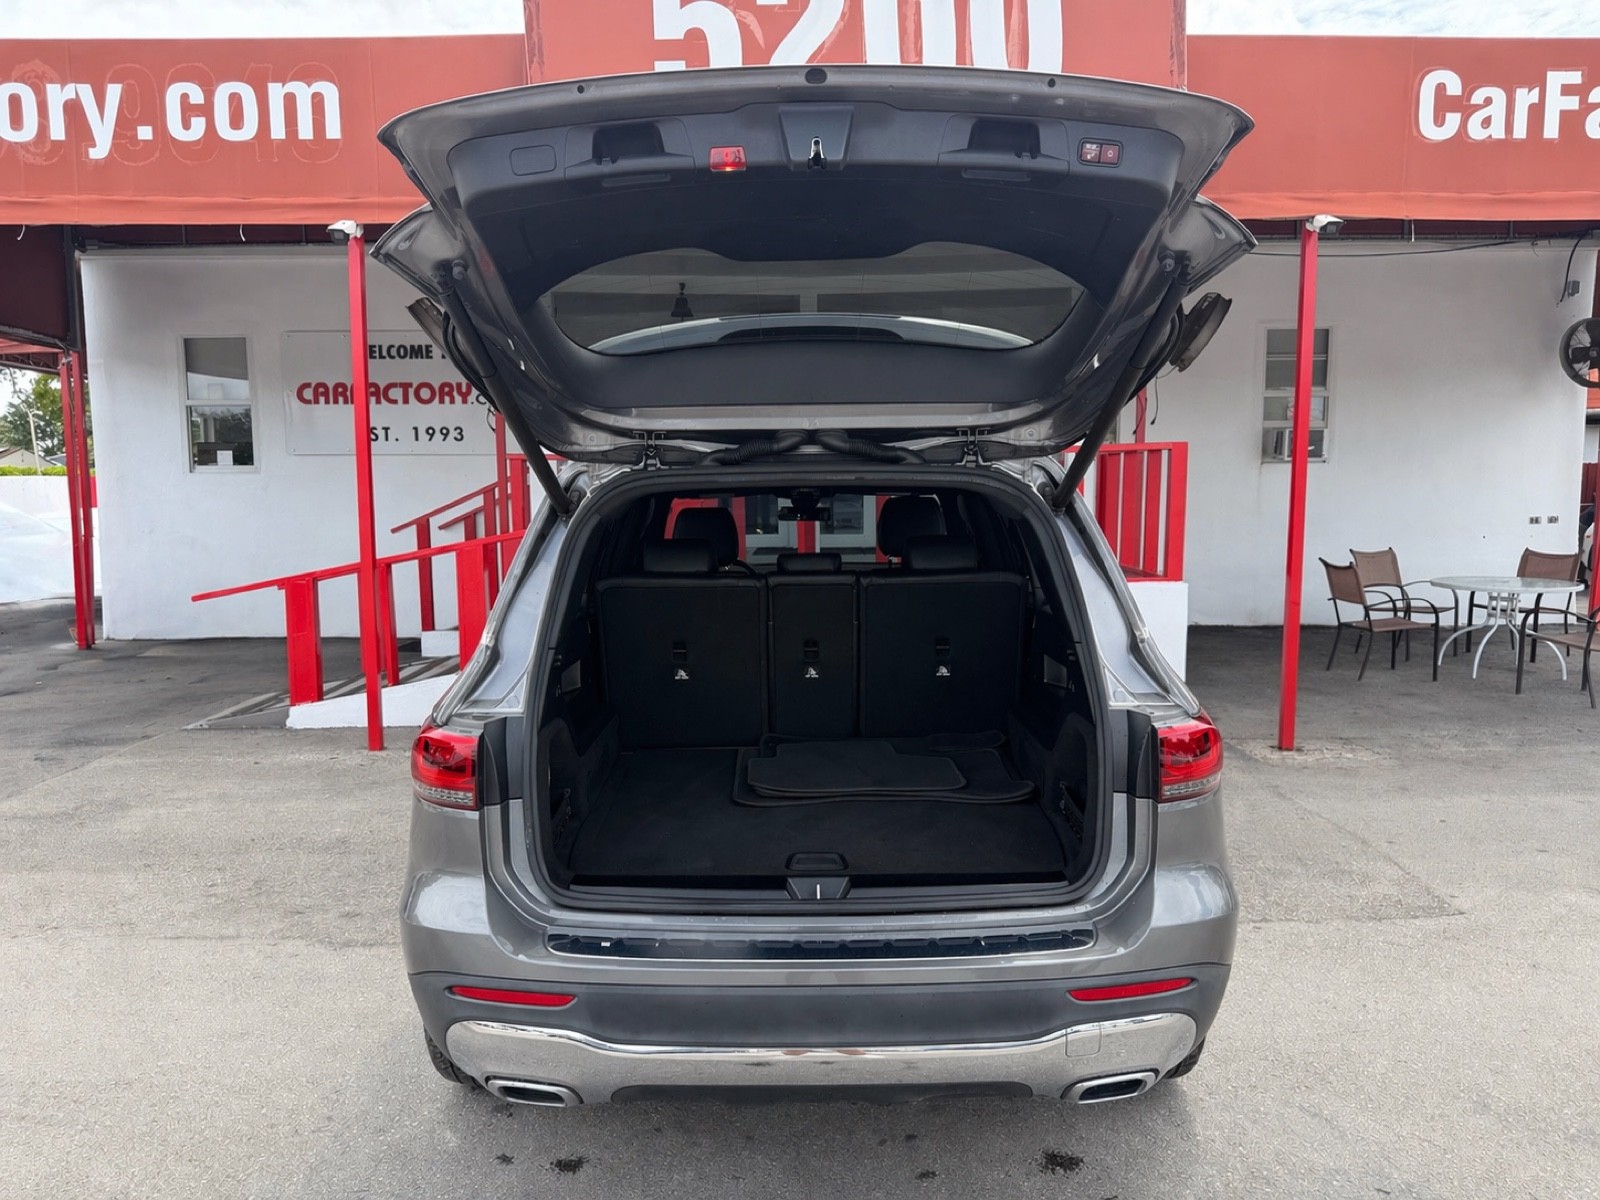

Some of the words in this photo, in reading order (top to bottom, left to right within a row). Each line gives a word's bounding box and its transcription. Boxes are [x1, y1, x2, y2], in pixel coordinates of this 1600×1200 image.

[369, 344, 433, 359] ELCOME
[370, 426, 399, 441] ST.
[412, 426, 464, 441] 1993
